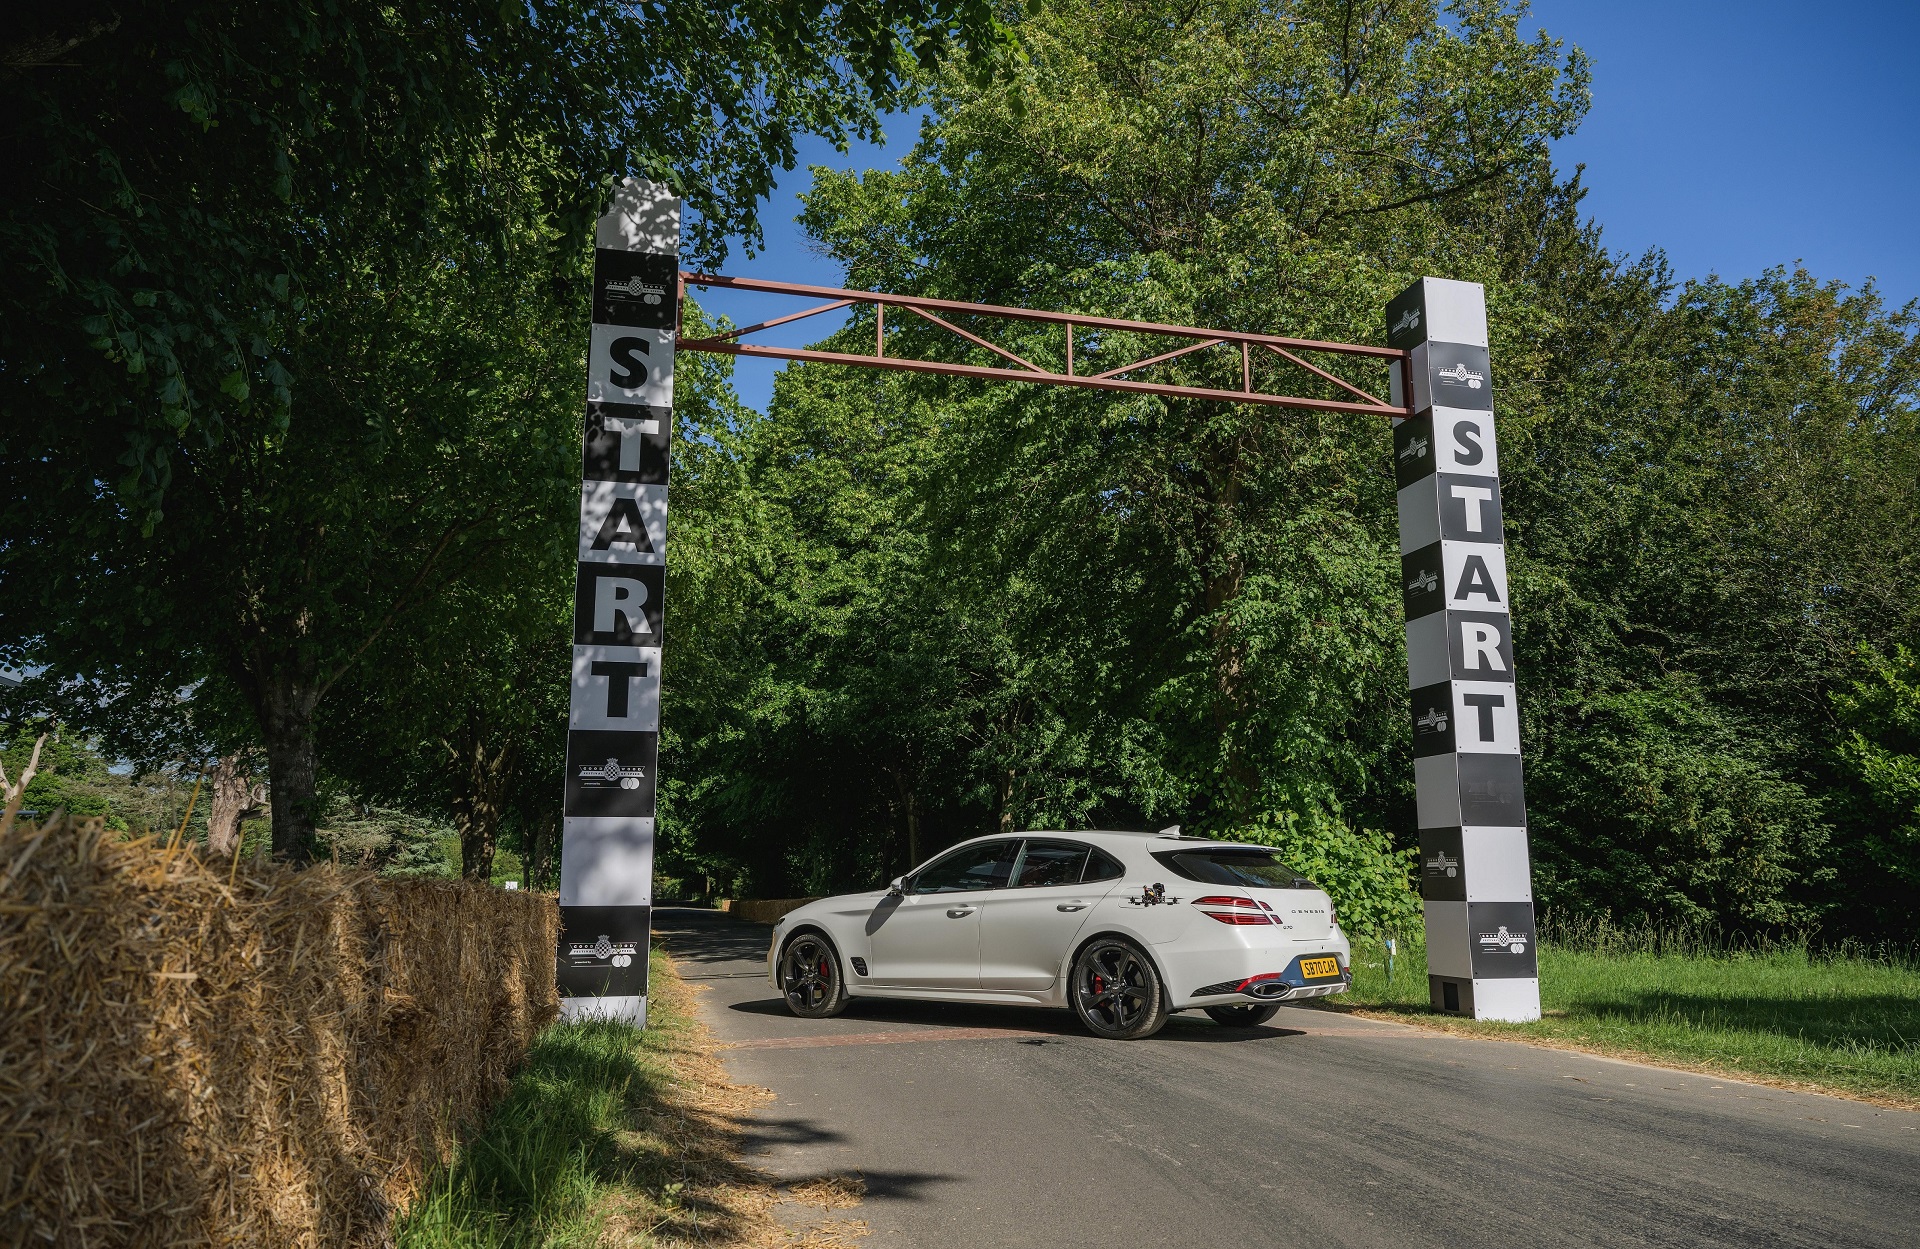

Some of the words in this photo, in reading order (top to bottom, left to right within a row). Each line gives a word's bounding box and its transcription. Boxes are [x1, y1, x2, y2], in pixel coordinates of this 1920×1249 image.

[589, 336, 660, 719] START
[1450, 420, 1508, 743] START
[1304, 961, 1324, 976] SB70
[1323, 960, 1337, 974] CAR
